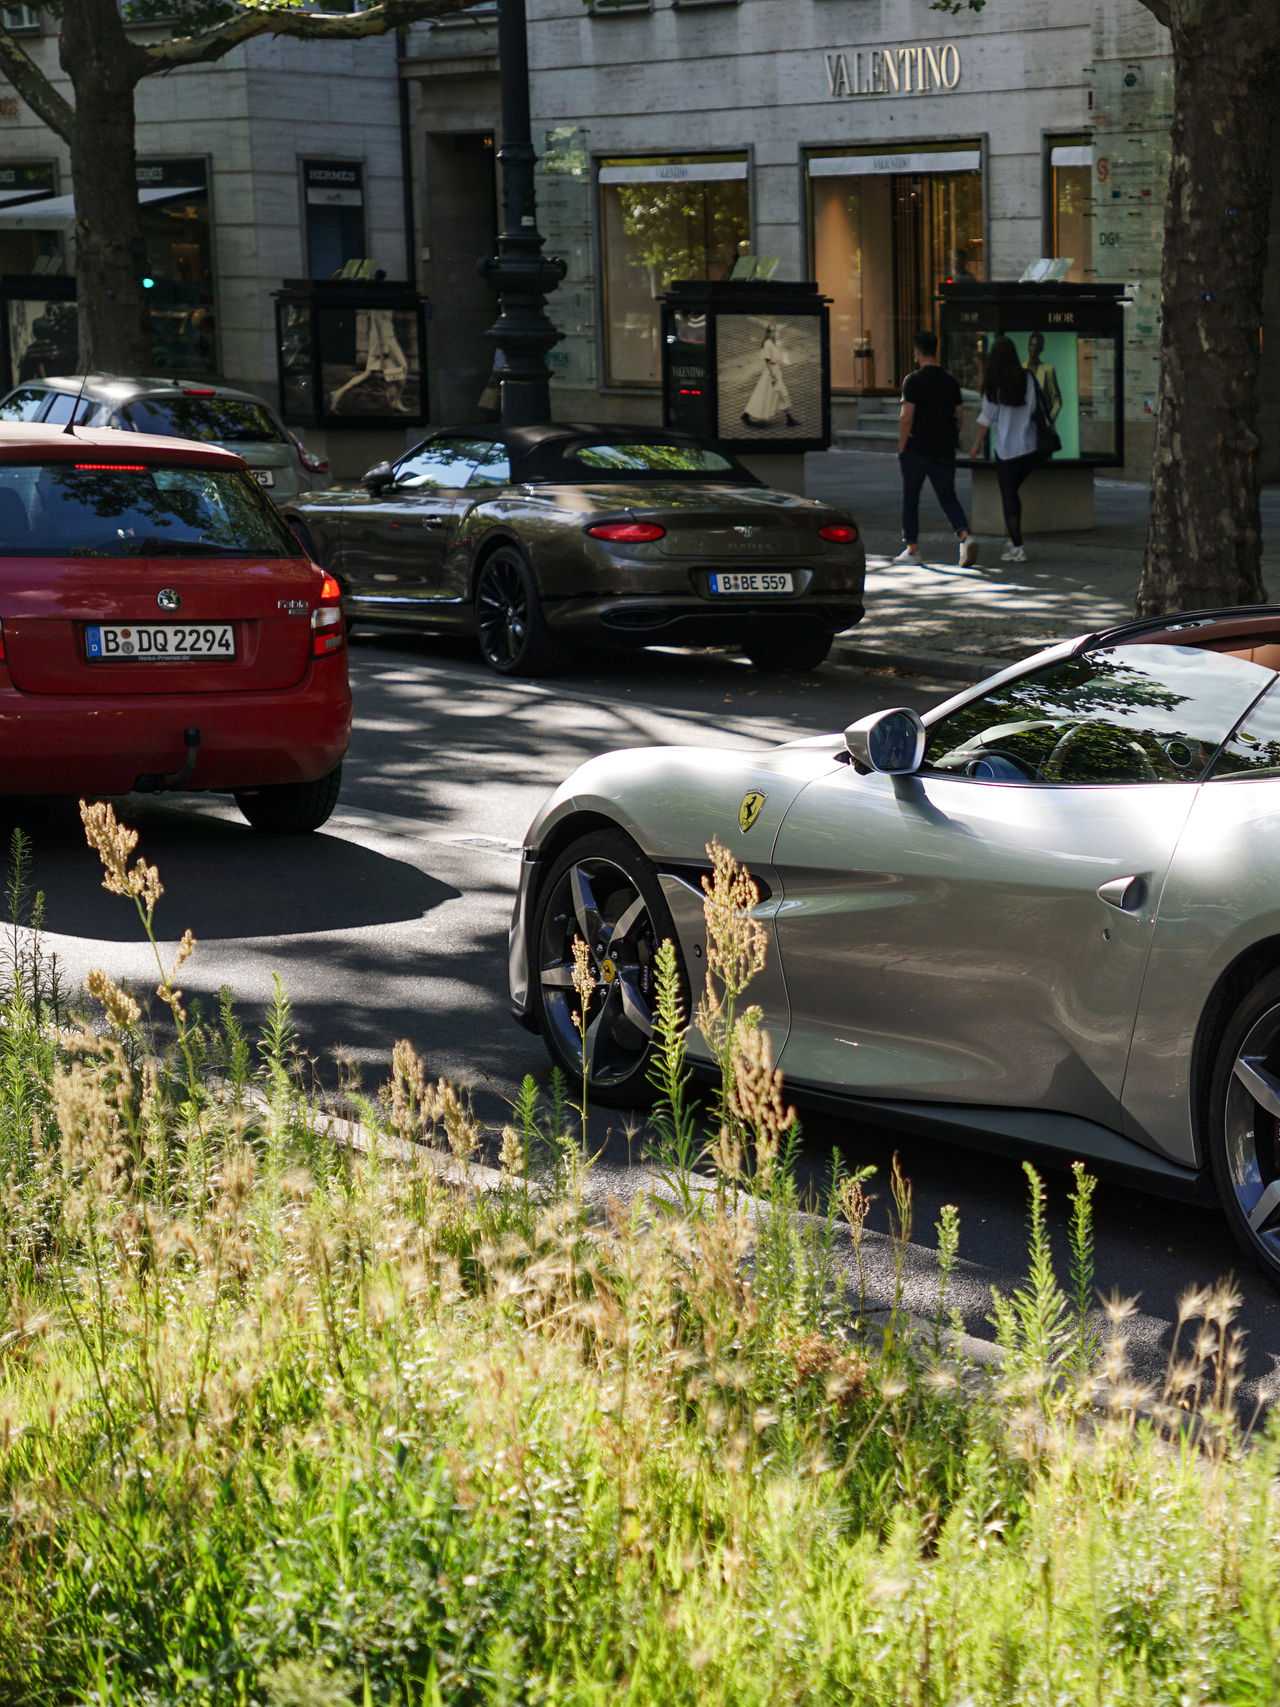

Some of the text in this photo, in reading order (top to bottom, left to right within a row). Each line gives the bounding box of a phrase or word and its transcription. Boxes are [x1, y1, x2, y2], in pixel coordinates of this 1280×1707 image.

[824, 43, 961, 96] VALENTINO
[1048, 312, 1075, 323] DIOR
[722, 575, 787, 591] B BE 559
[277, 600, 309, 609] Fabia
[104, 629, 231, 653] B DQ 2294
